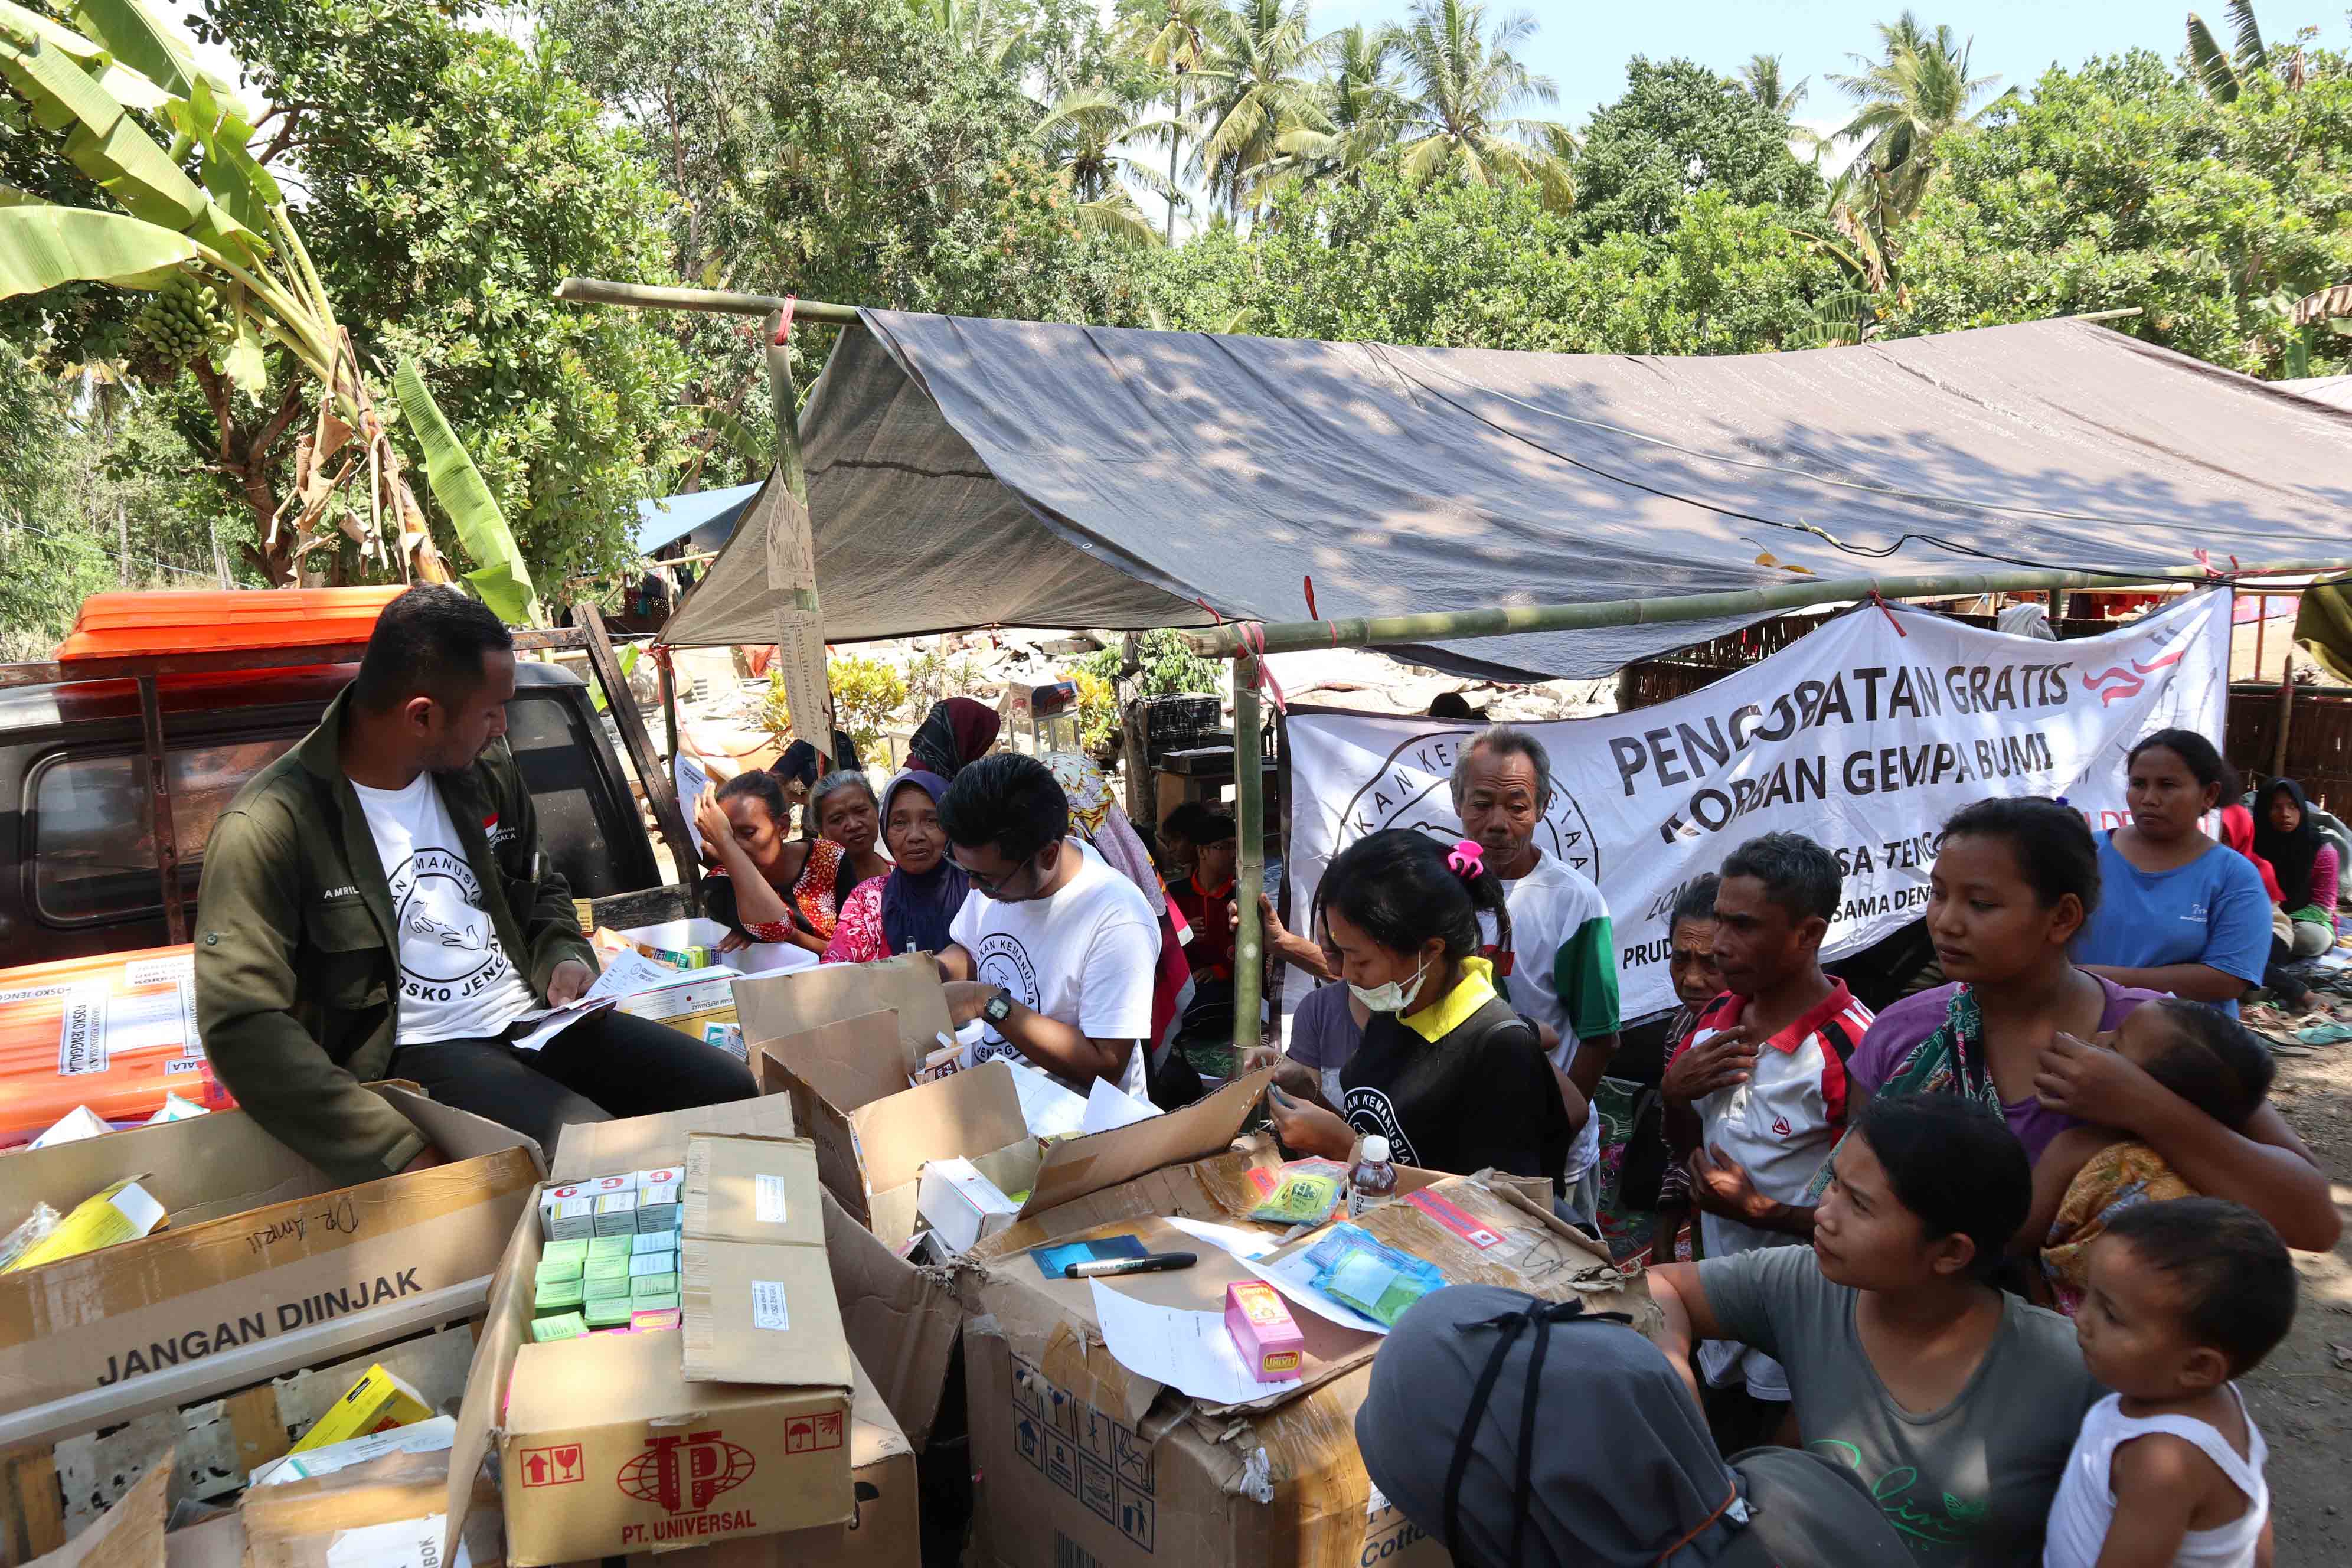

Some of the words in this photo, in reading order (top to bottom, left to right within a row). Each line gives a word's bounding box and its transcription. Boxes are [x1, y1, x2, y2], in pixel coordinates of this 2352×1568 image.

[1945, 662, 2074, 714] GRATIS
[1843, 743, 1975, 796] GEMPA
[1975, 733, 2053, 780] BUMI
[72, 1005, 87, 1030] POSKO
[68, 1030, 86, 1073] JENGGALA
[97, 1312, 267, 1387] JANGAN
[276, 1267, 423, 1333] DIINJAK
[622, 1524, 649, 1546] PT.
[653, 1509, 757, 1541] UNIVERSAL
[419, 1536, 440, 1568] BOK
